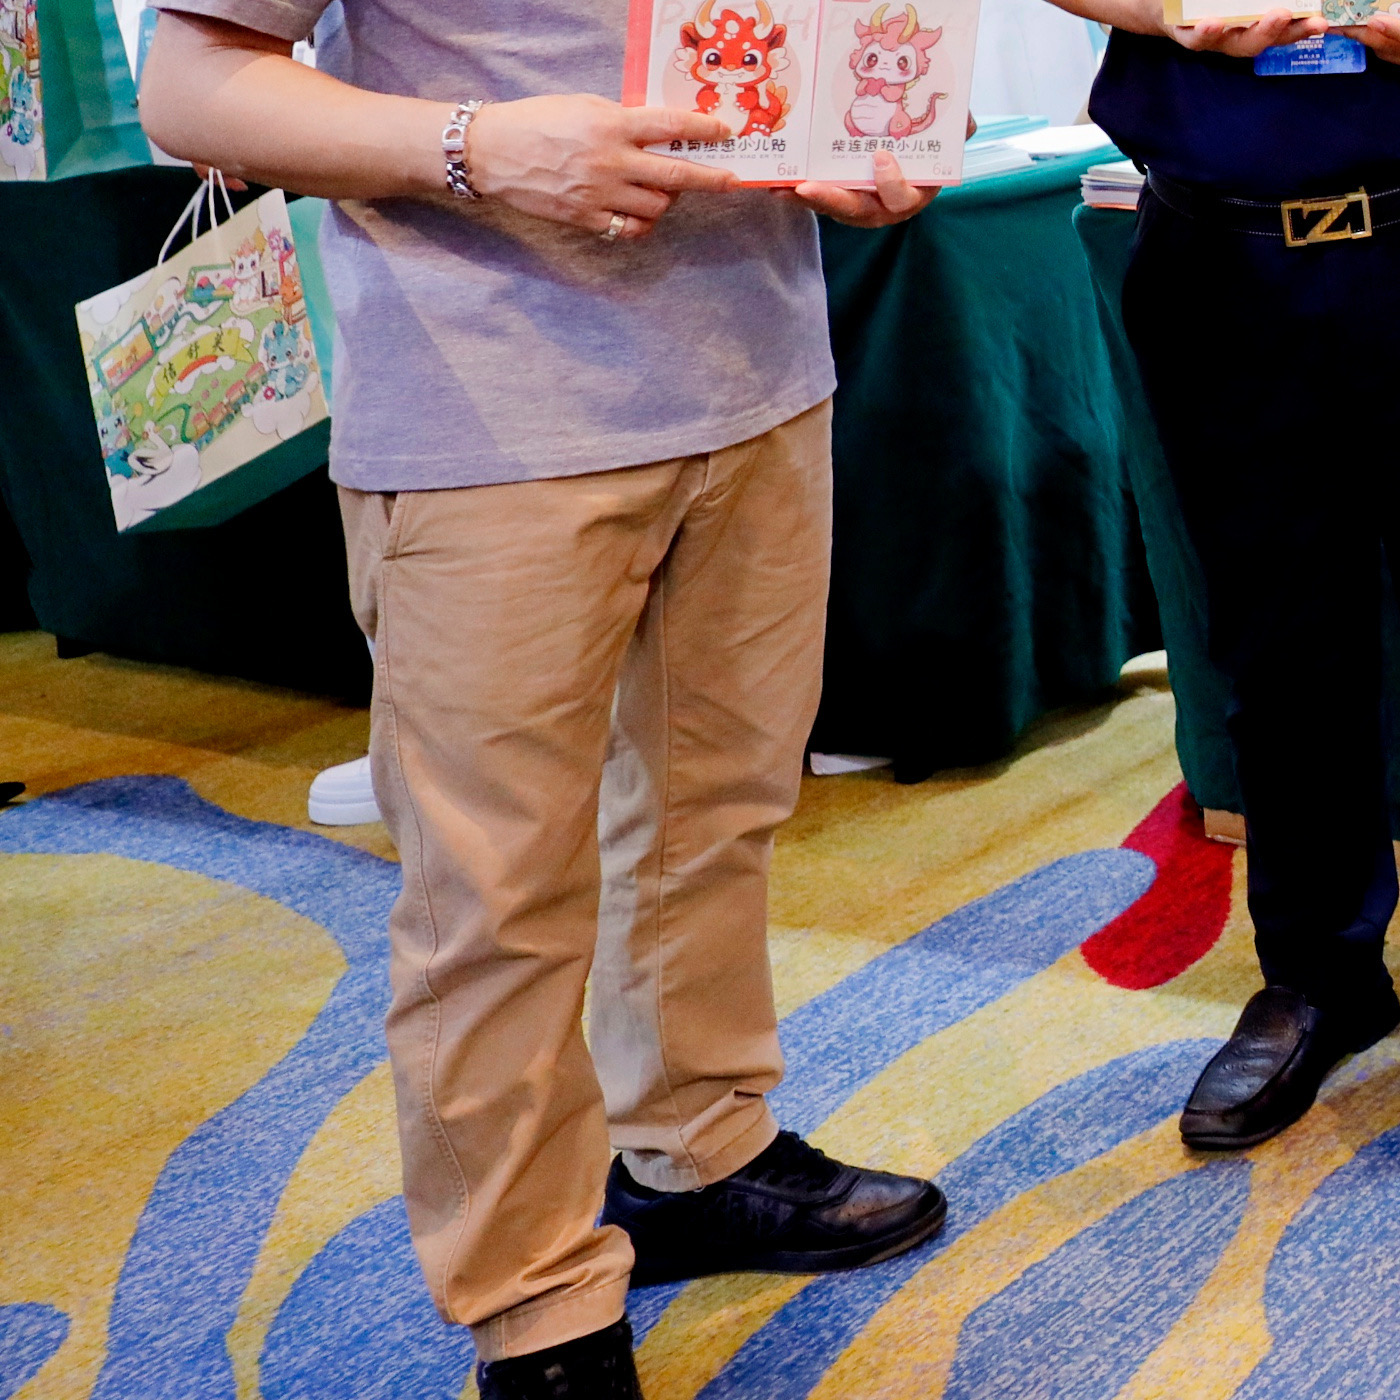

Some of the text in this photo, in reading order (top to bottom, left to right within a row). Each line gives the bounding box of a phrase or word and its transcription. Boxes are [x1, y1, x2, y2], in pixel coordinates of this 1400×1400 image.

[832, 139, 941, 153] 柴连退热小儿贴
